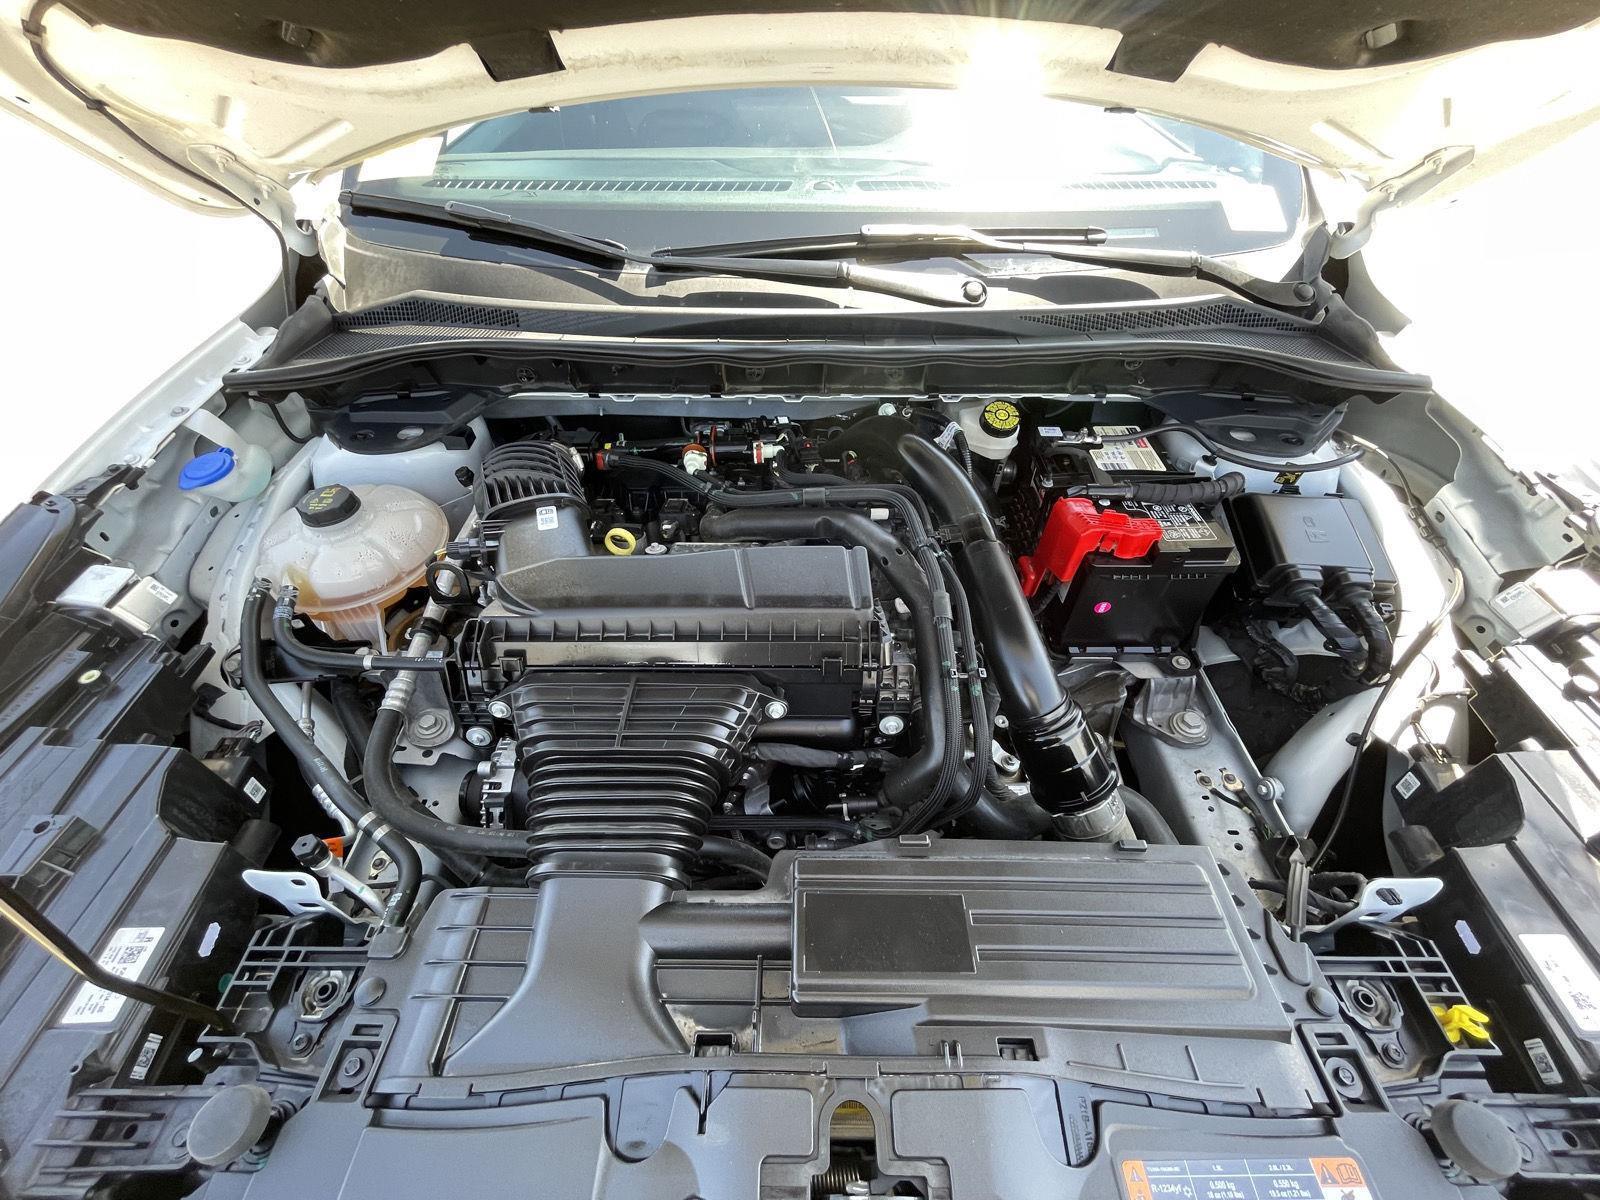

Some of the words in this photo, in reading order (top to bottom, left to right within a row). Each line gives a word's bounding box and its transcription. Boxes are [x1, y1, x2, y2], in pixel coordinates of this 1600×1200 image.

[1151, 1184, 1181, 1194] R-1234yf
[1226, 1180, 1236, 1191] kg
[1289, 1179, 1300, 1189] kg
